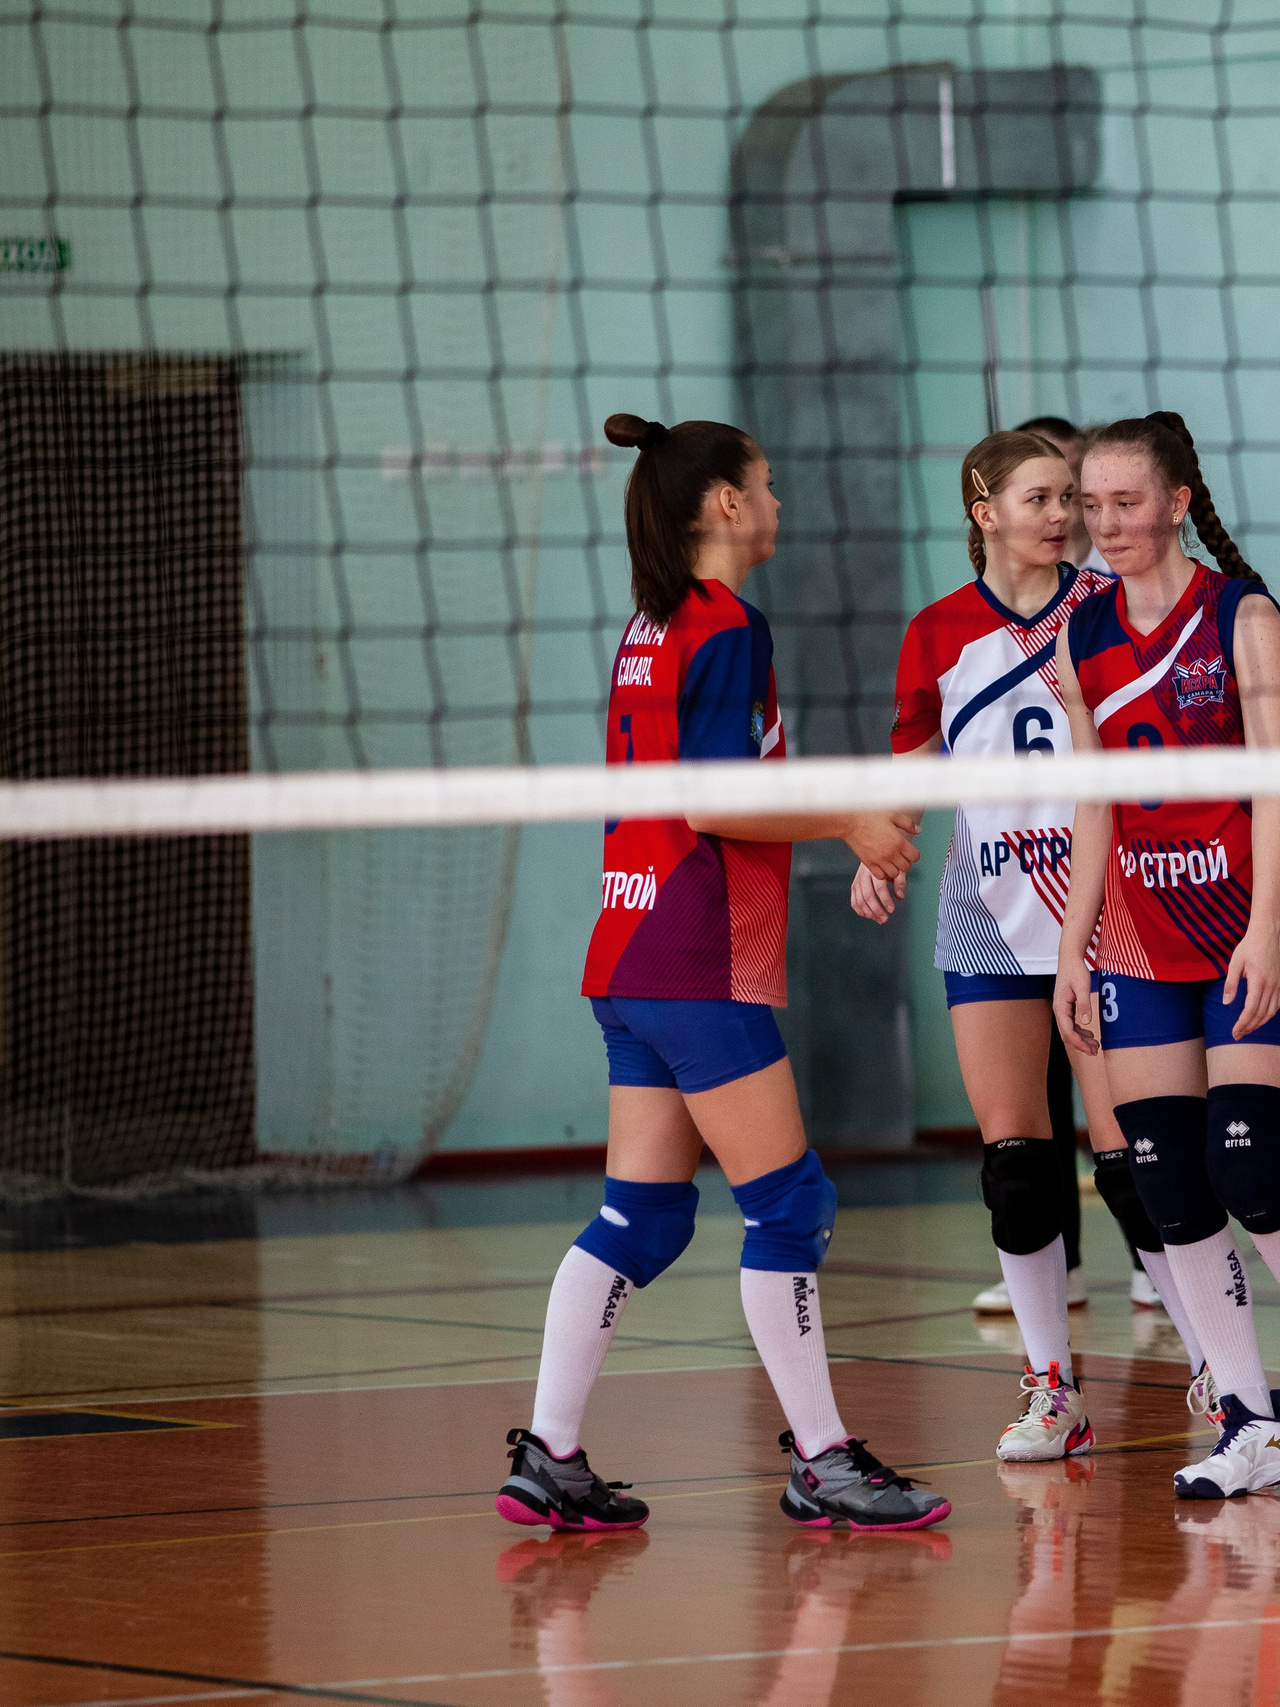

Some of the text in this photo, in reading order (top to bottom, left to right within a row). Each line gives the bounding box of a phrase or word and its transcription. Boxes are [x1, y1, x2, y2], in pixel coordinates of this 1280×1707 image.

[1181, 675, 1218, 694] ИСКРА
[1187, 690, 1214, 699] САМАРА
[980, 836, 1072, 877] АР СТР
[1139, 838, 1228, 888] СТРОЙ
[602, 866, 657, 910] ТРОЙ
[1102, 982, 1119, 1022] 3
[1226, 1250, 1248, 1307] MIKASA
[600, 1275, 627, 1329] MIKASA
[793, 1276, 813, 1337] MIKASA
